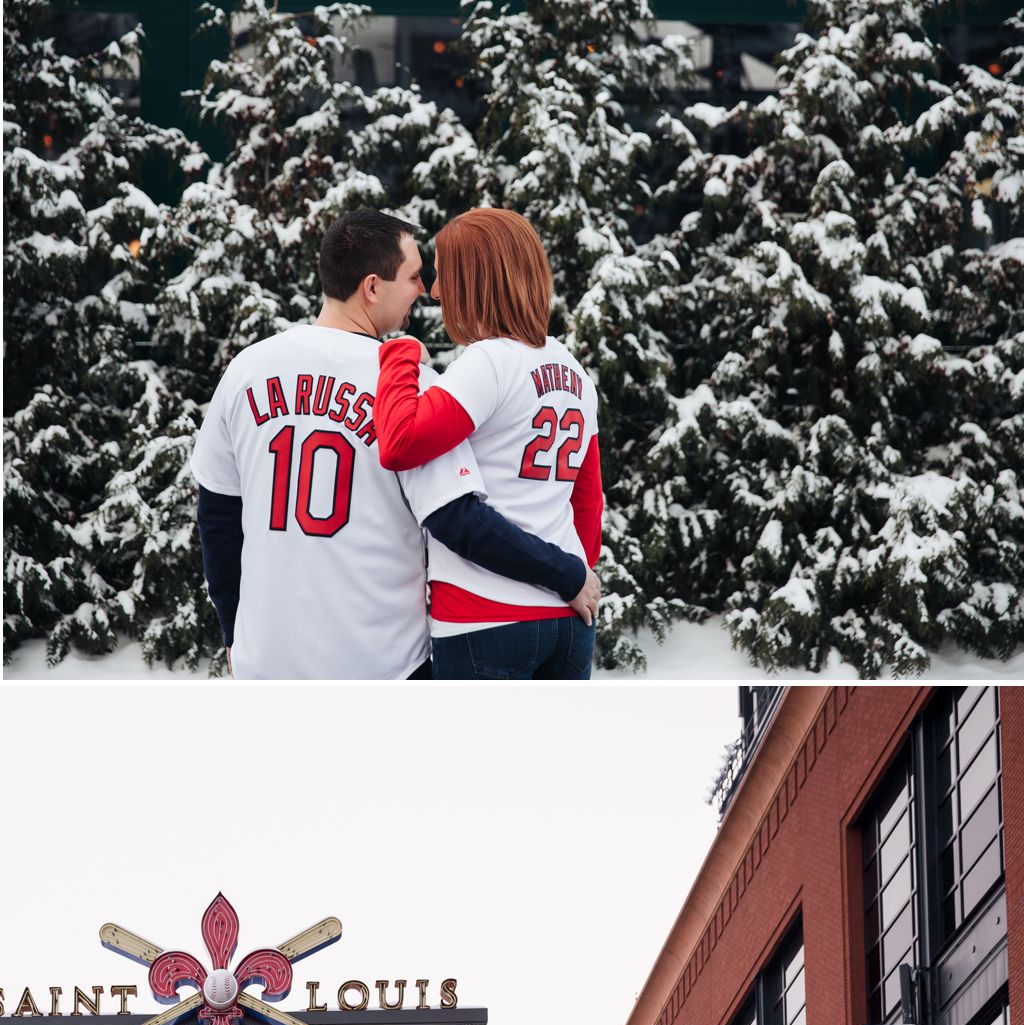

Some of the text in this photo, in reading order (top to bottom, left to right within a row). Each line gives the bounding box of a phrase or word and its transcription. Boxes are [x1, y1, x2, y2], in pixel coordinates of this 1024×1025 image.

[246, 376, 290, 427] LA
[518, 405, 585, 481] 22
[269, 425, 356, 537] 10
[305, 978, 459, 1012] LOUIS
